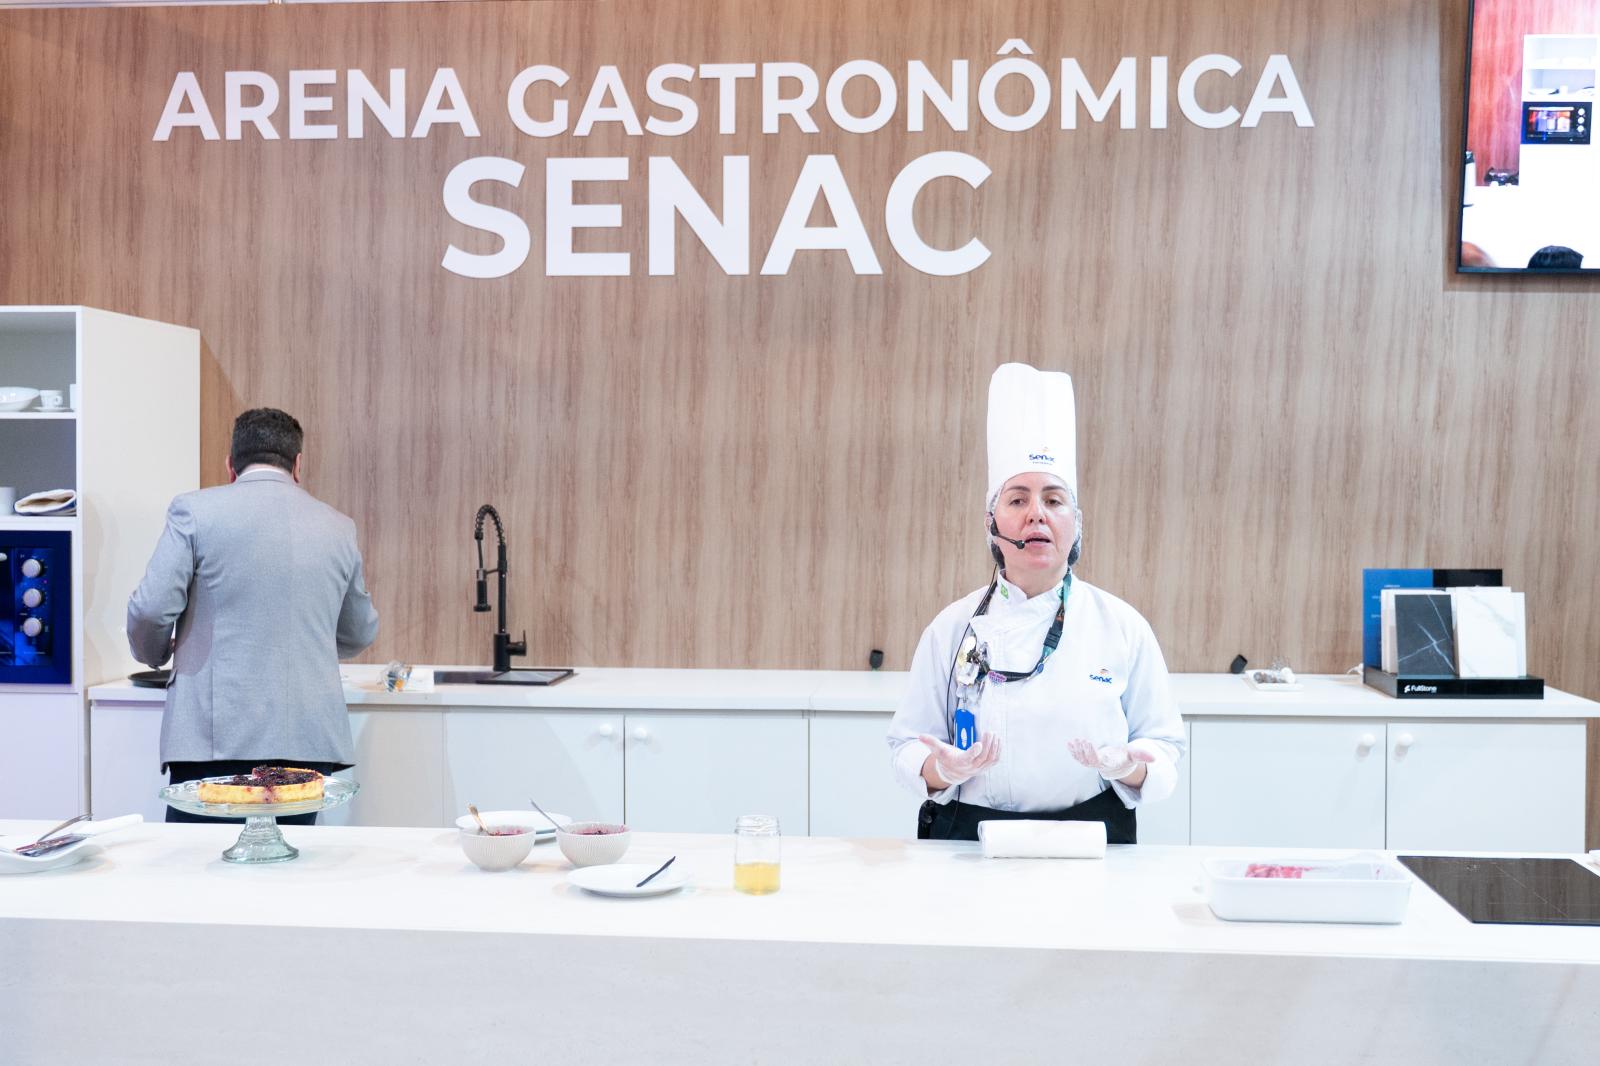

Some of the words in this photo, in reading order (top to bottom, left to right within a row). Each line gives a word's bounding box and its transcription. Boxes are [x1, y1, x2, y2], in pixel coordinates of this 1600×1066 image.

[152, 67, 481, 141] ARENA
[507, 38, 1316, 137] GASTRONÔMICA
[441, 150, 992, 279] SENAC
